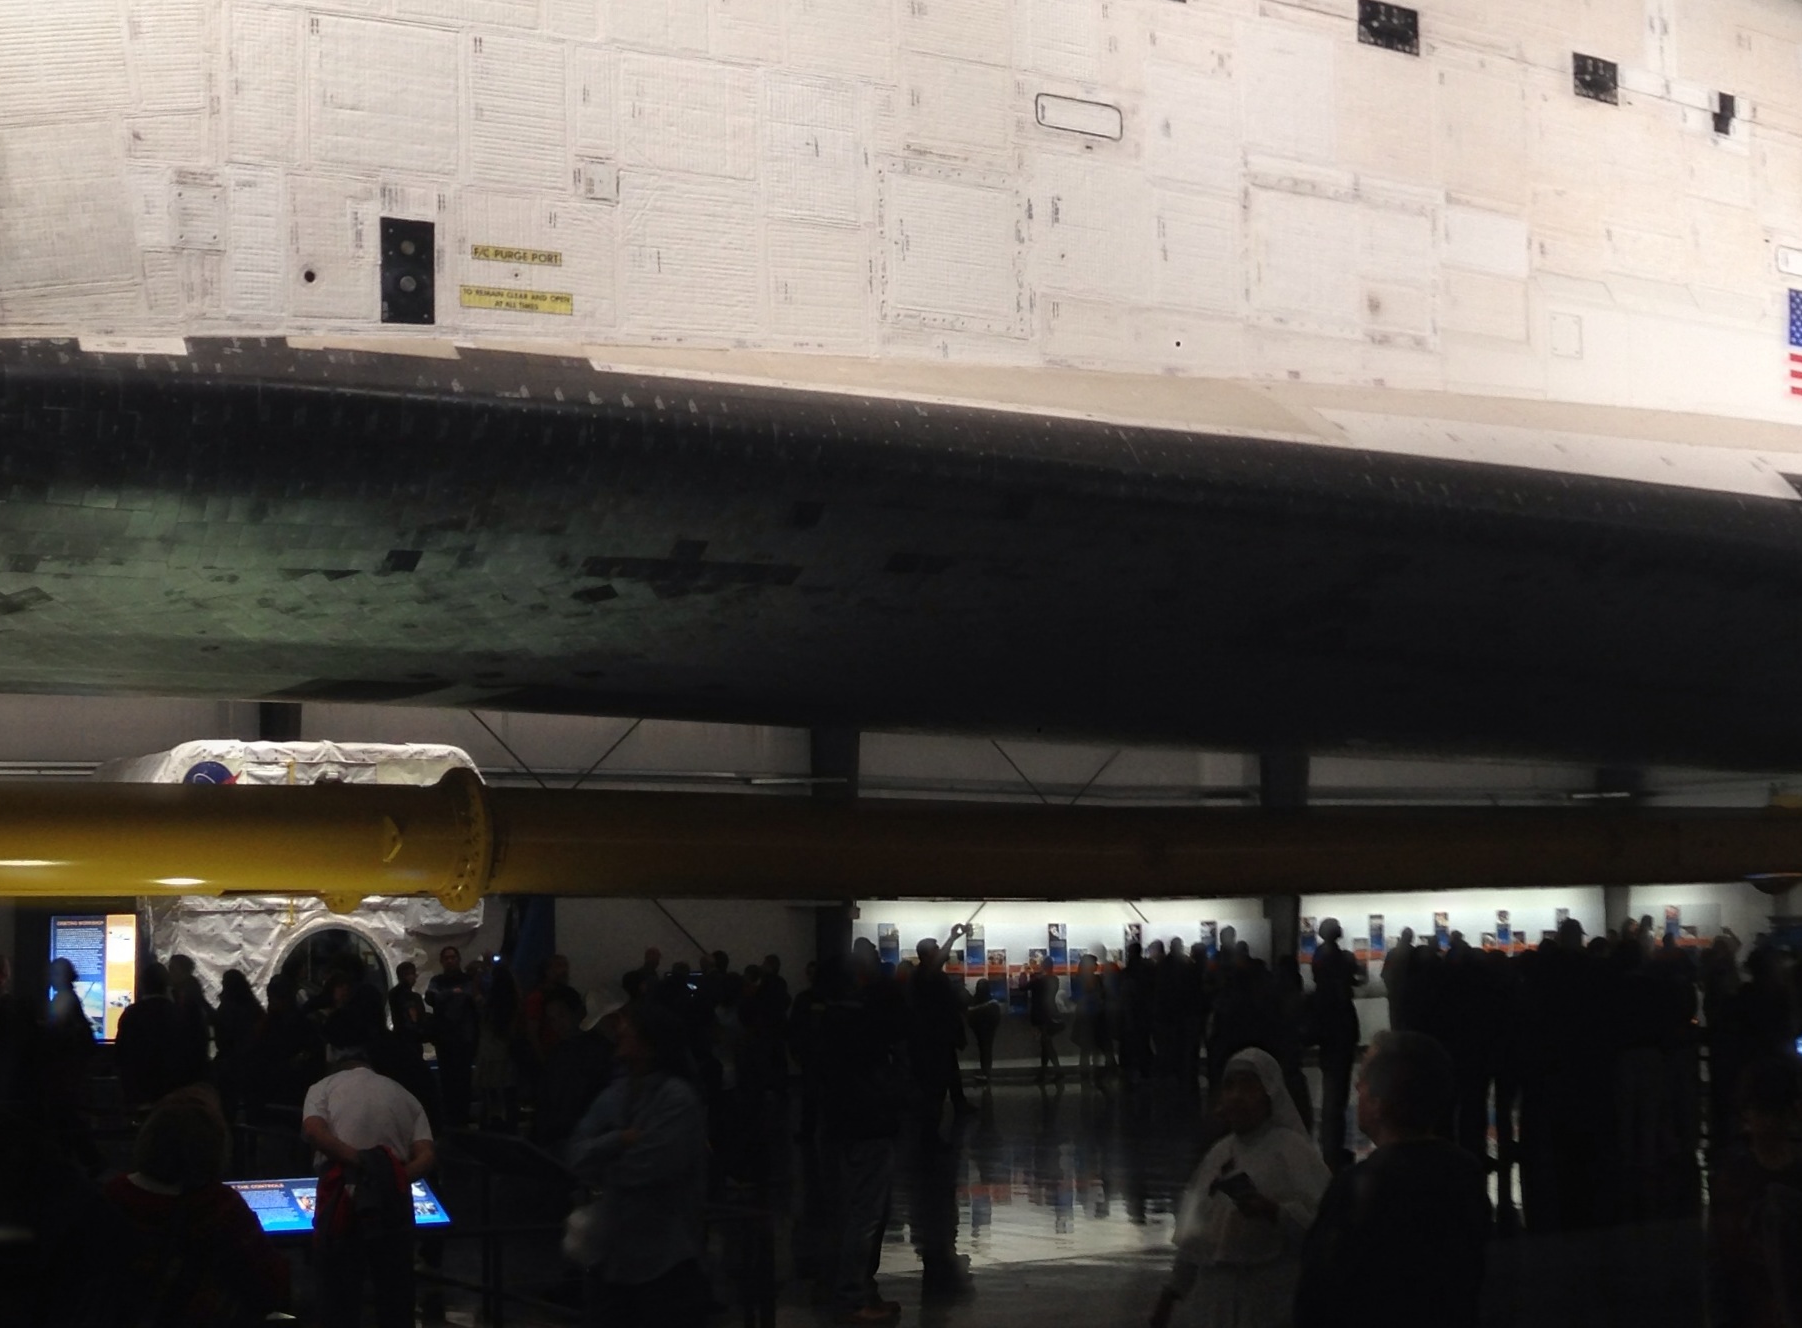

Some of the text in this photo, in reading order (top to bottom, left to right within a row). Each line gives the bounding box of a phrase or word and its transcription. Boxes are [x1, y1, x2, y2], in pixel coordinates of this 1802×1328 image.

[473, 247, 558, 264] F/C PURGE PORT
[475, 289, 504, 298] REMAIN
[506, 291, 528, 300] CLEAR
[550, 295, 570, 303] OPEN
[494, 300, 539, 310] AT ALL TIMES
